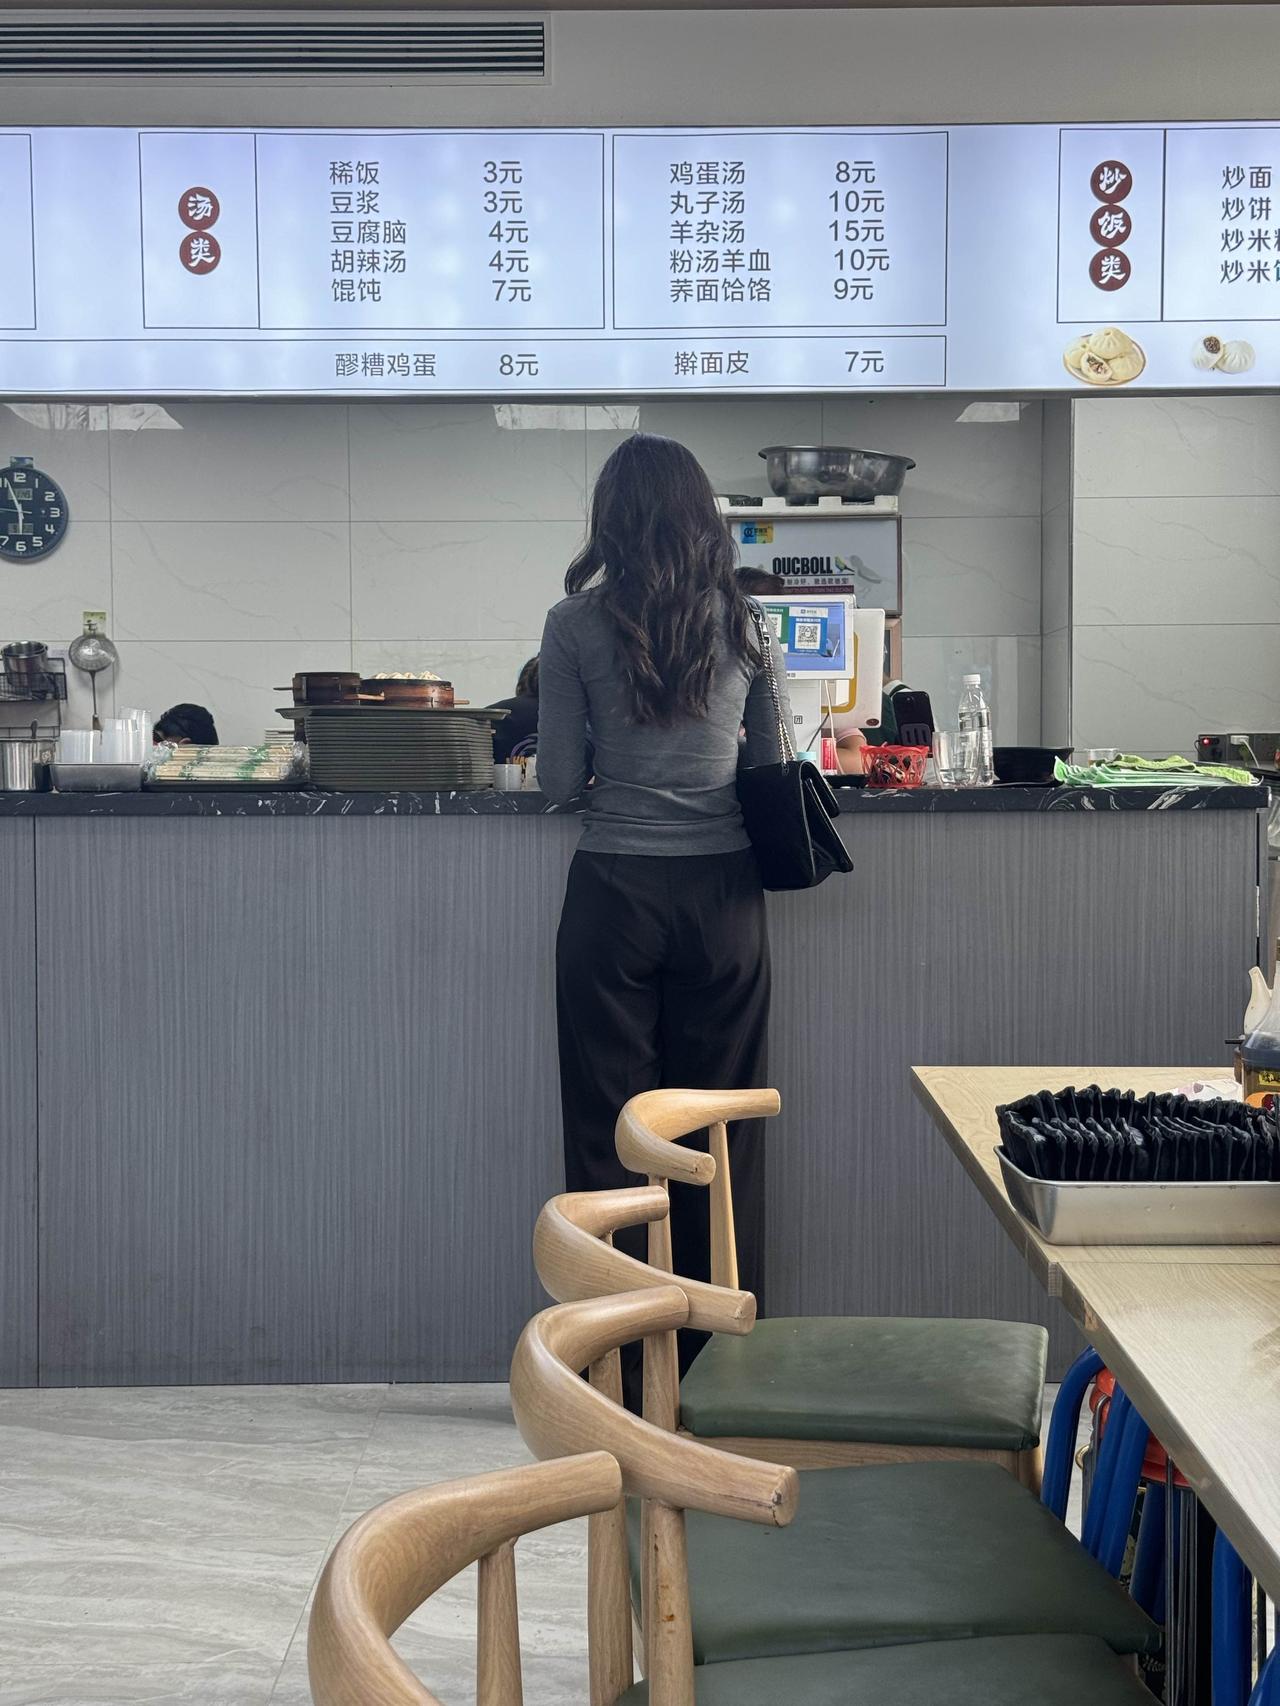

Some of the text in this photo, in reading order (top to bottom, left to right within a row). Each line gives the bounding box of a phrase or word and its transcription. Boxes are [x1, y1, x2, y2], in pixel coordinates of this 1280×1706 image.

[329, 160, 523, 185] 稀饭 3元
[669, 160, 876, 185] 鸡蛋汤 8元
[1221, 165, 1273, 190] 炒面
[329, 190, 523, 215] 豆浆 3元
[669, 189, 885, 215] 丸子汤 10元
[1221, 196, 1272, 222] 炒饼
[187, 193, 216, 267] 汤类
[330, 219, 529, 244] 豆腐脑 4元
[669, 219, 885, 245] 羊杂汤 15元
[1098, 166, 1128, 285] 炒饭类
[330, 249, 529, 274] 胡辣汤 4元
[669, 248, 890, 274] 粉汤羊血 10元
[331, 277, 532, 303] 馄饨 7元
[669, 277, 874, 304] 荞面饸饹 9元
[335, 352, 539, 377] 醪糟鸡蛋 8元
[674, 349, 885, 376] 擀面皮 7元
[44, 491, 55, 502] 2
[49, 507, 60, 518] 3
[32, 536, 43, 547] 5
[45, 524, 55, 534] 4
[16, 541, 26, 551] 6
[772, 556, 833, 575] OUCBOLL
